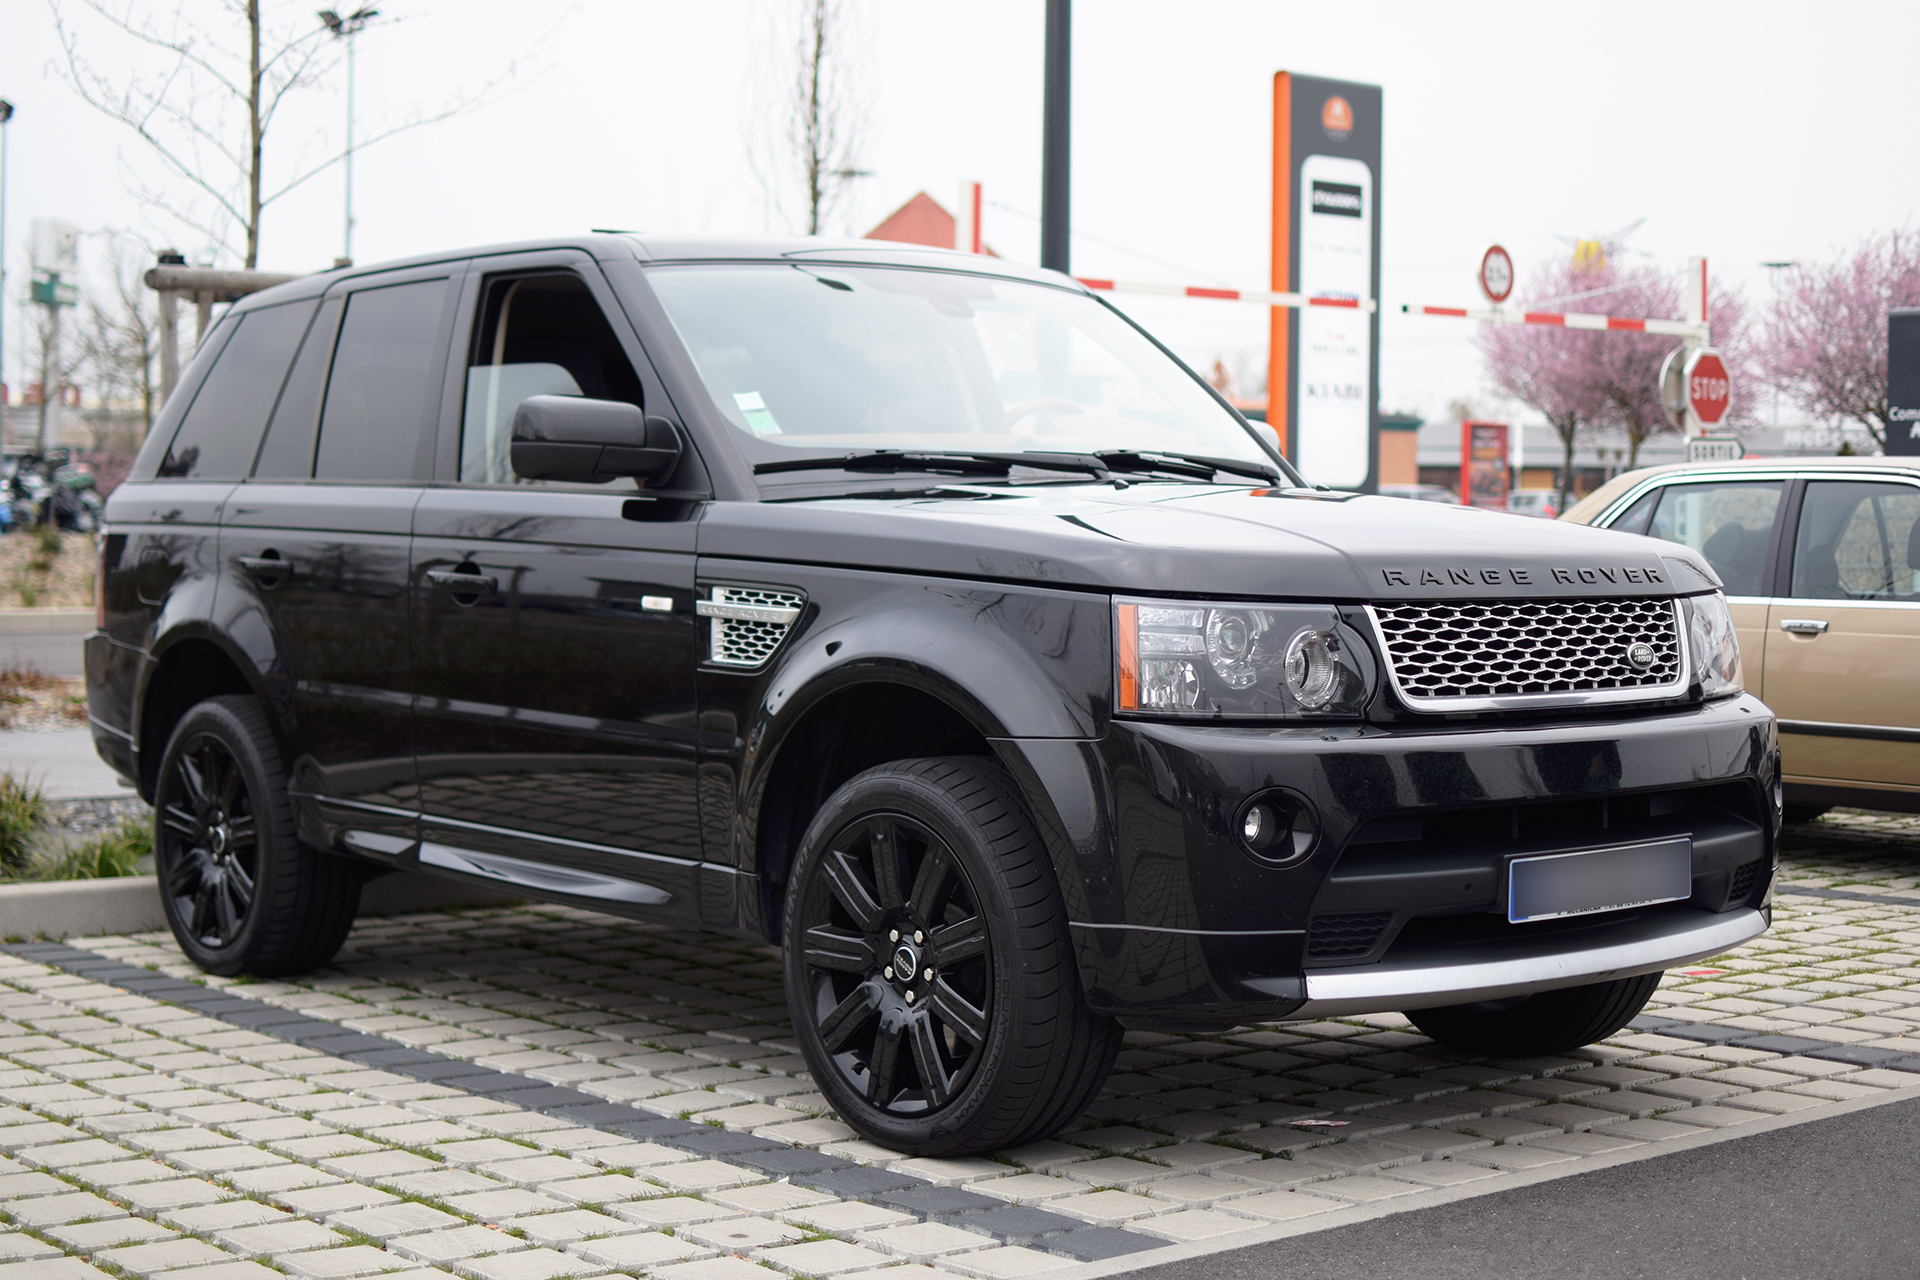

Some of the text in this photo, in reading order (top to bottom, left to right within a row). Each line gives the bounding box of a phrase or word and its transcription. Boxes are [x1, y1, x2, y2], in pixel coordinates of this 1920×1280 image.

[1692, 376, 1728, 401] STOP
[1694, 444, 1734, 460] SORTIE
[1382, 567, 1664, 586] RANGE ROVER
[700, 605, 778, 620] RANGE ROVER
